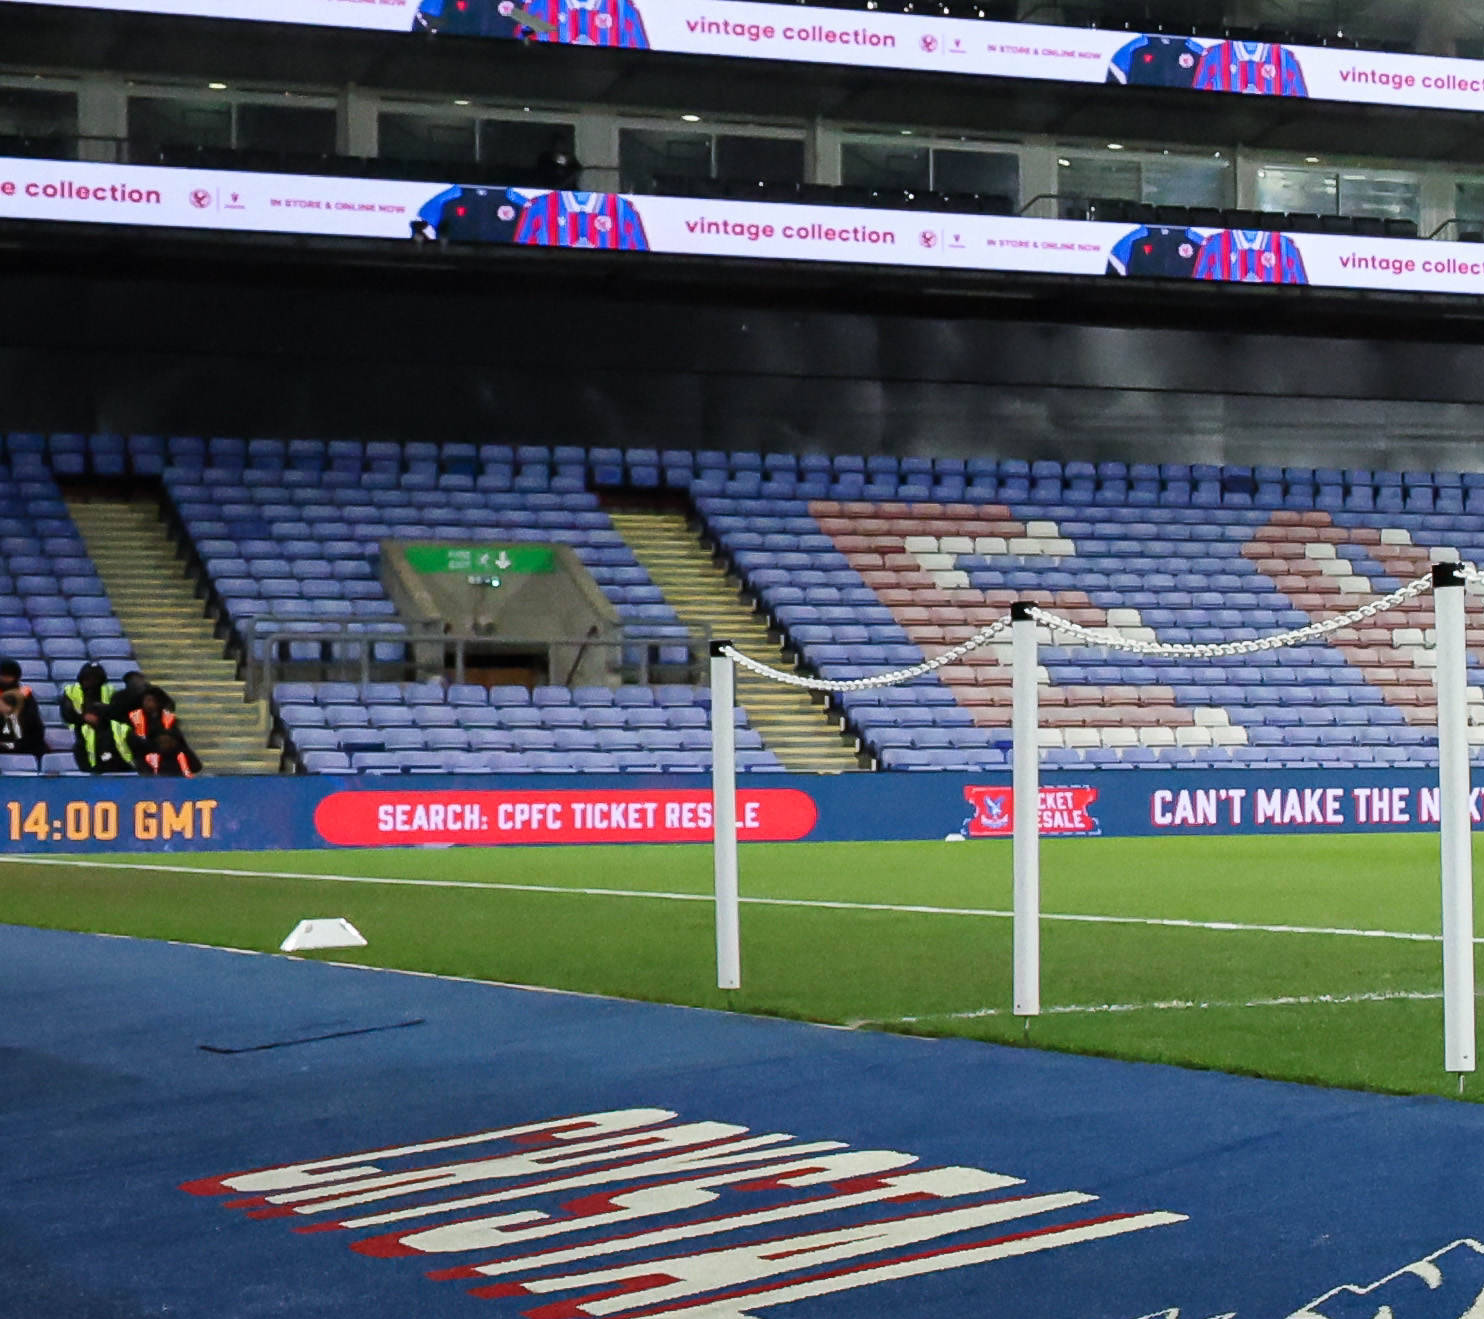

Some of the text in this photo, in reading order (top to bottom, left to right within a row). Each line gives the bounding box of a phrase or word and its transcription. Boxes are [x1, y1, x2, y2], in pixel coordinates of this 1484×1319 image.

[685, 15, 896, 48] vintage collection
[1338, 66, 1416, 90] vintage
[24, 180, 160, 204] collection
[684, 215, 895, 244] vintage collection
[1338, 251, 1416, 275] vintage
[7, 799, 219, 841] 14:00 GMT
[377, 803, 488, 832] SEARCH:
[497, 802, 563, 832] CPFC
[571, 802, 656, 831] TICKET
[1152, 788, 1245, 827] CAN'T
[1254, 787, 1344, 825] MAKE
[1352, 786, 1410, 825] THE
